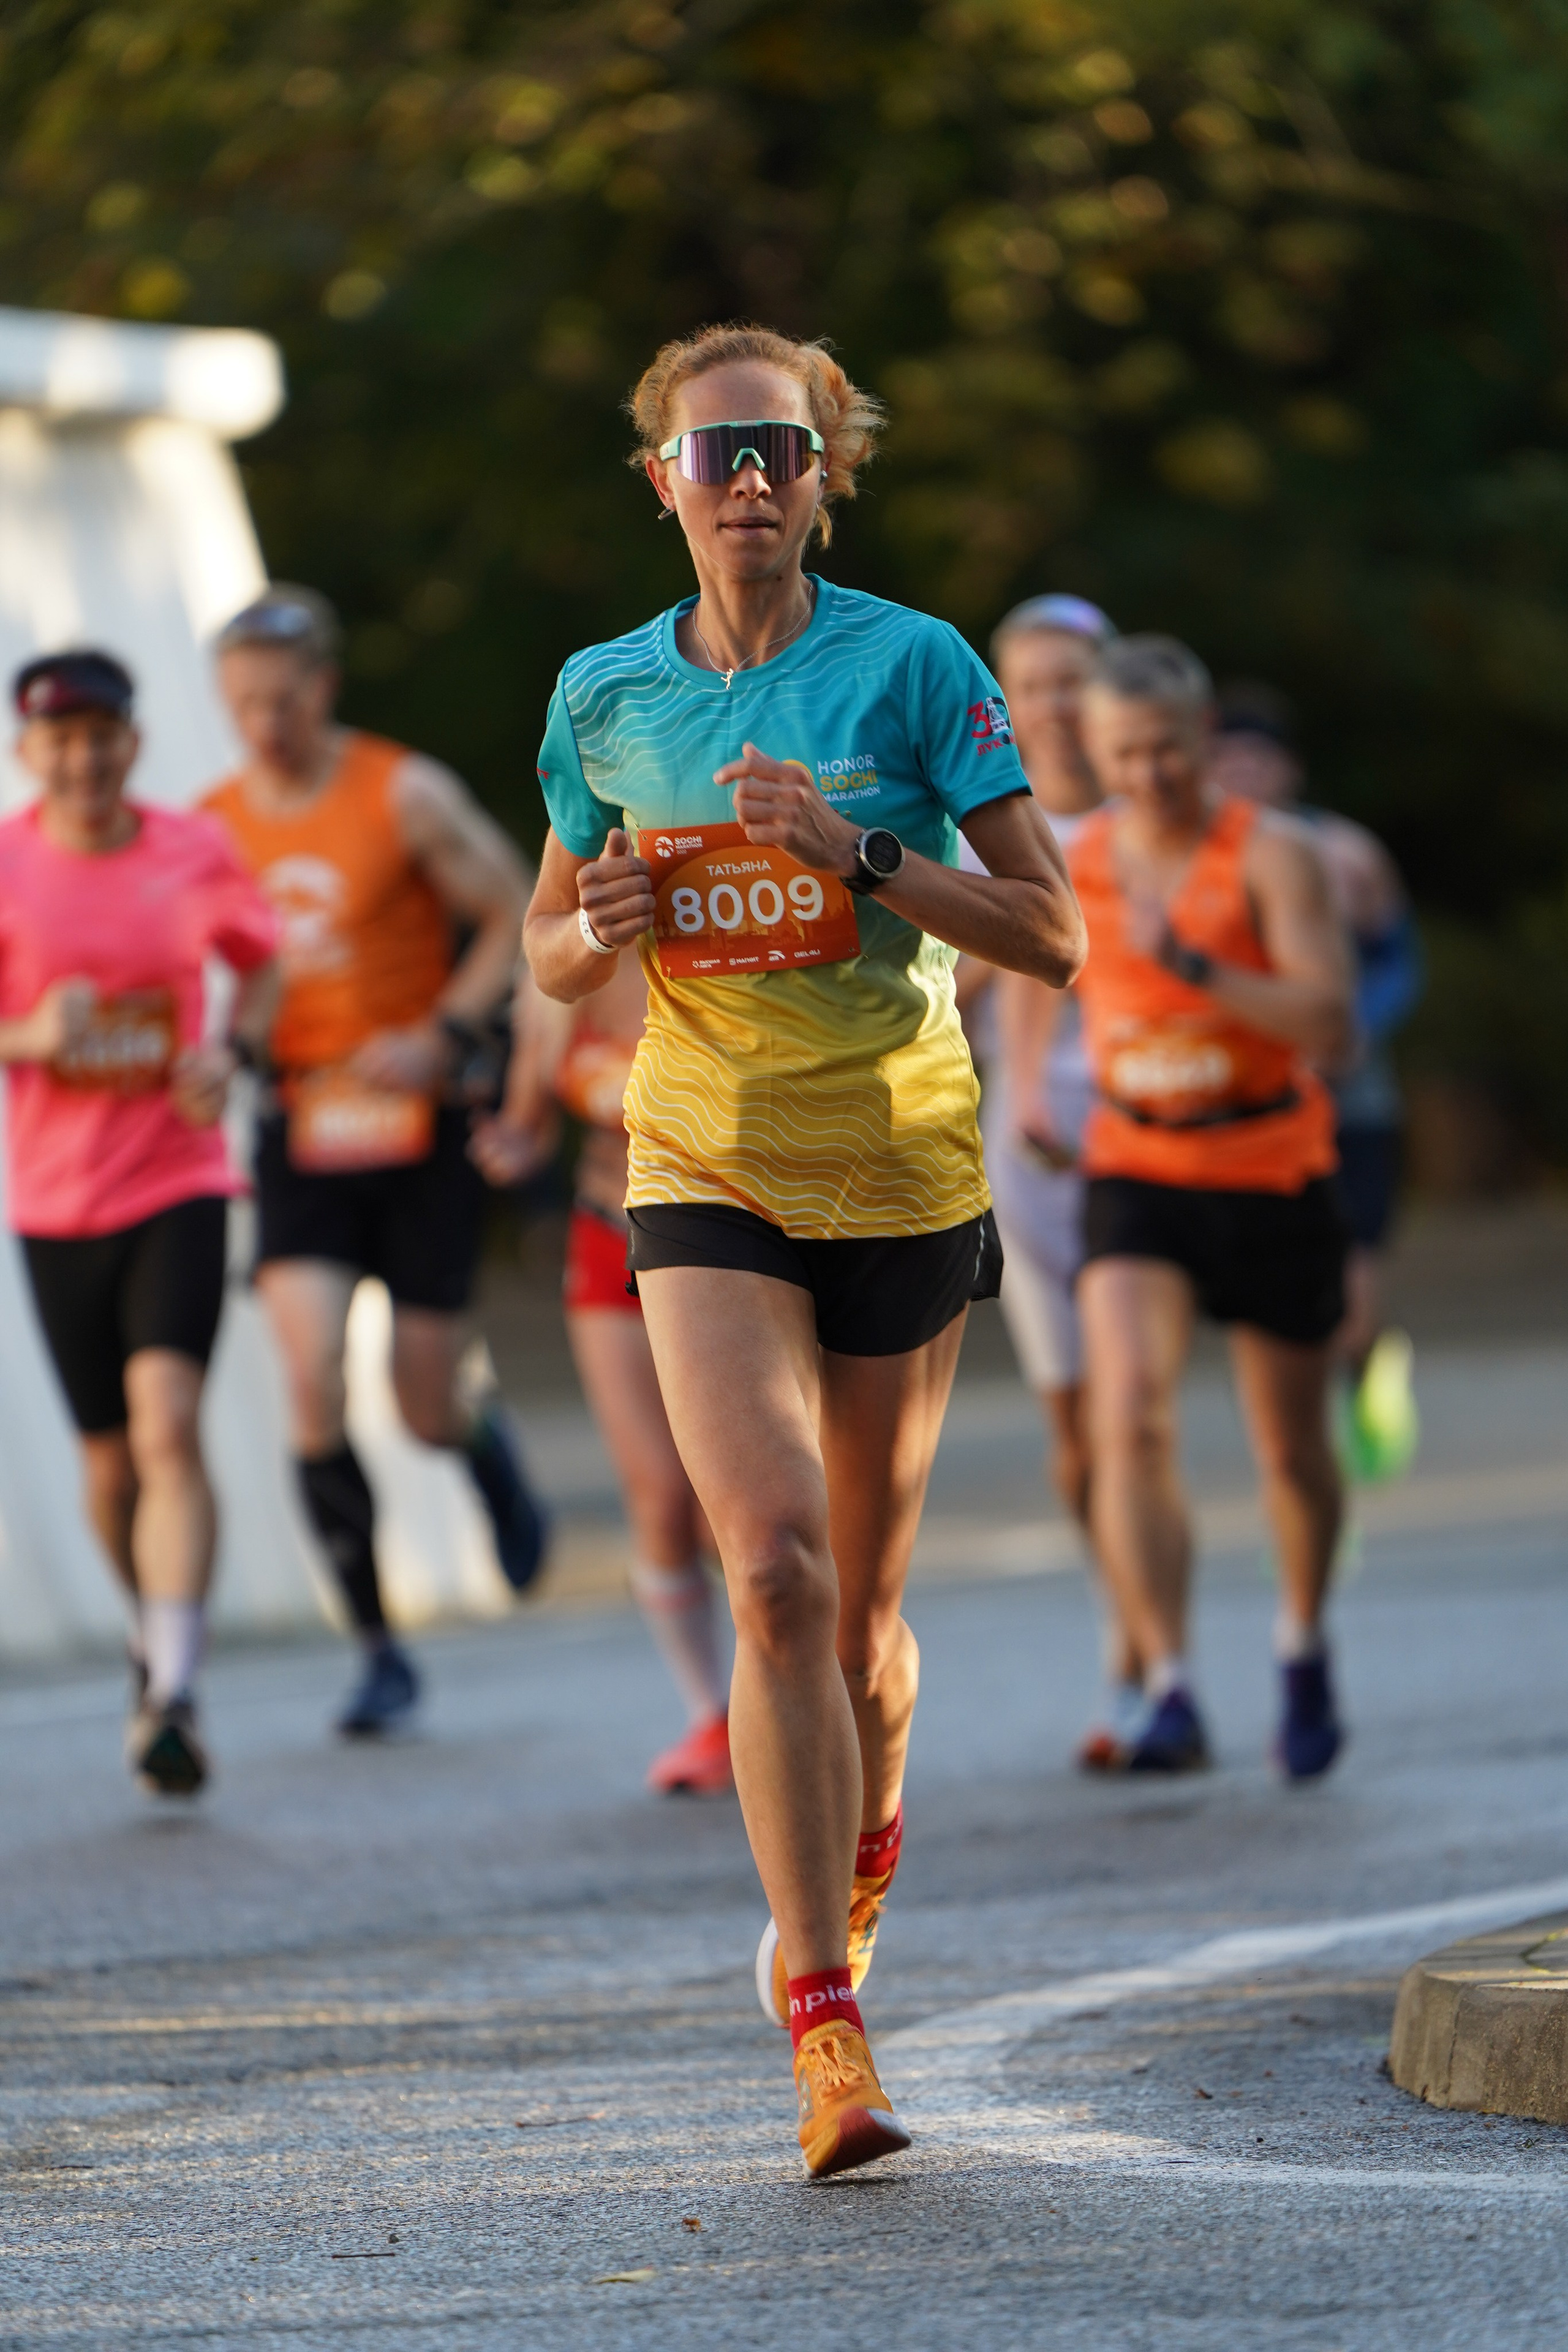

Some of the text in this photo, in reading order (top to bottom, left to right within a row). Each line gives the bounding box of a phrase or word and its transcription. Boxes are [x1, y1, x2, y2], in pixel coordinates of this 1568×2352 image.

[817, 754, 875, 775] HONOR
[820, 769, 878, 791] SOCHI
[822, 786, 881, 802] MARATHON
[674, 835, 703, 845] SOCHI
[706, 859, 772, 876] ТАТЬЯНА
[671, 875, 824, 932] 8009
